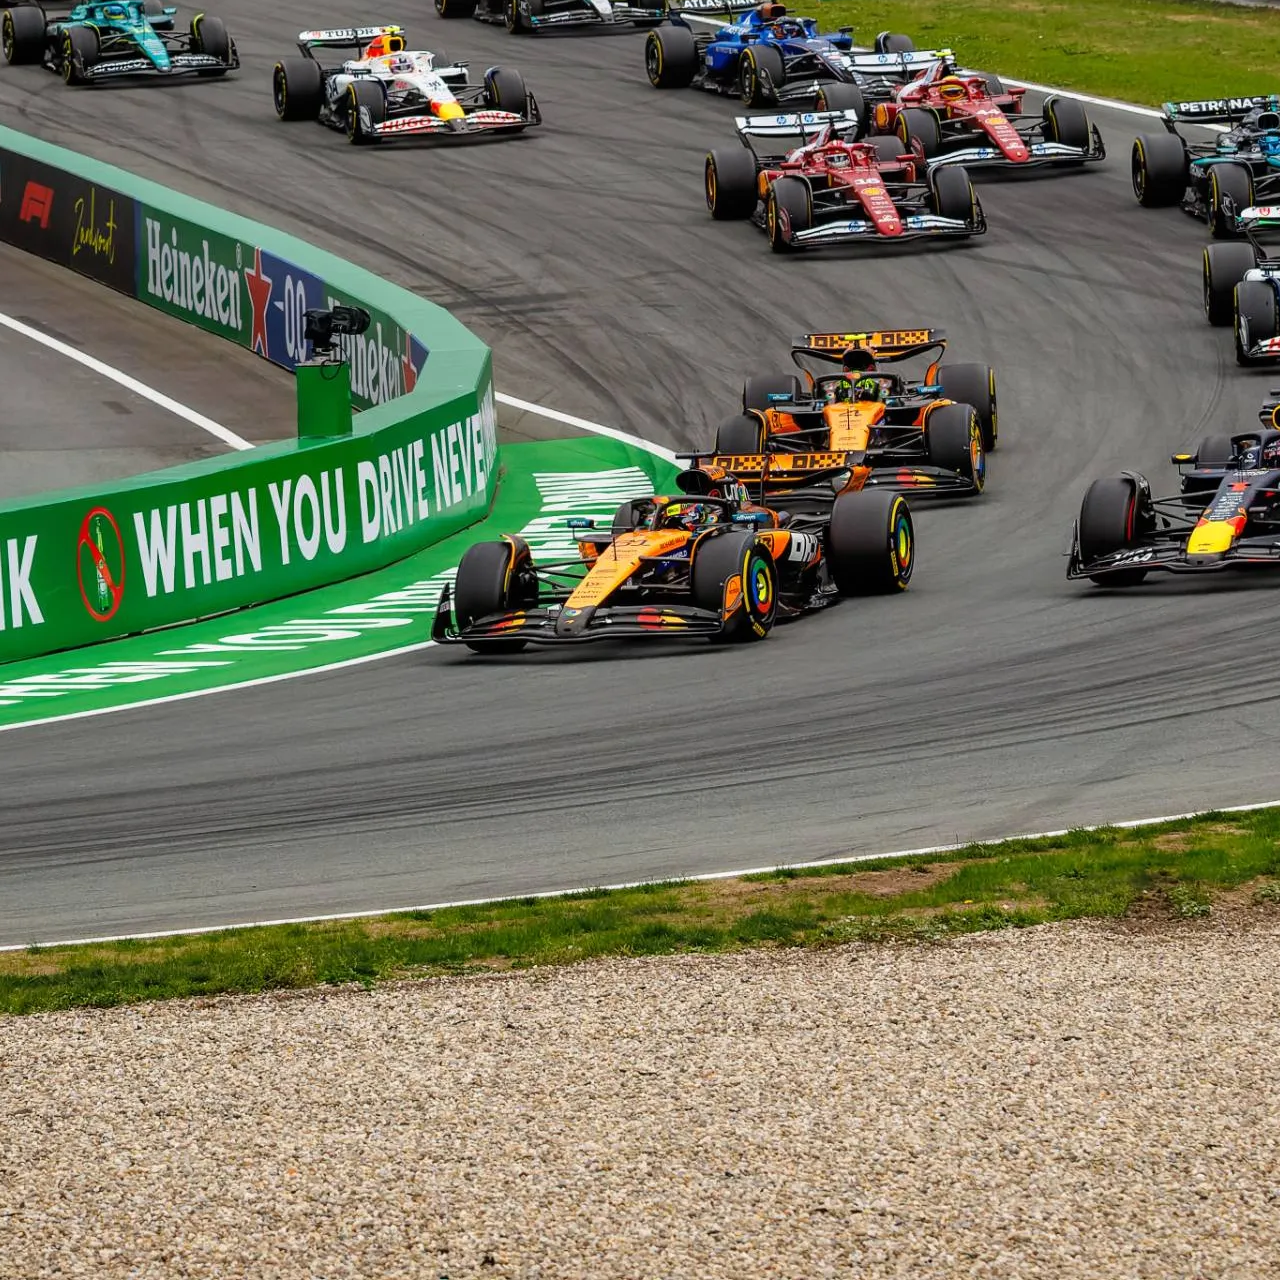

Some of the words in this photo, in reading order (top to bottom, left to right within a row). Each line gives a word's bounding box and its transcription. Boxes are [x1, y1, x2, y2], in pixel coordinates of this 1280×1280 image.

[1180, 95, 1263, 112] PETRONAS
[382, 115, 433, 131] HUGO
[284, 274, 308, 364] 0.0
[133, 488, 264, 598] WHEN
[271, 467, 348, 568] YOU
[357, 439, 430, 544] DRIVE
[153, 618, 414, 650] YOU
